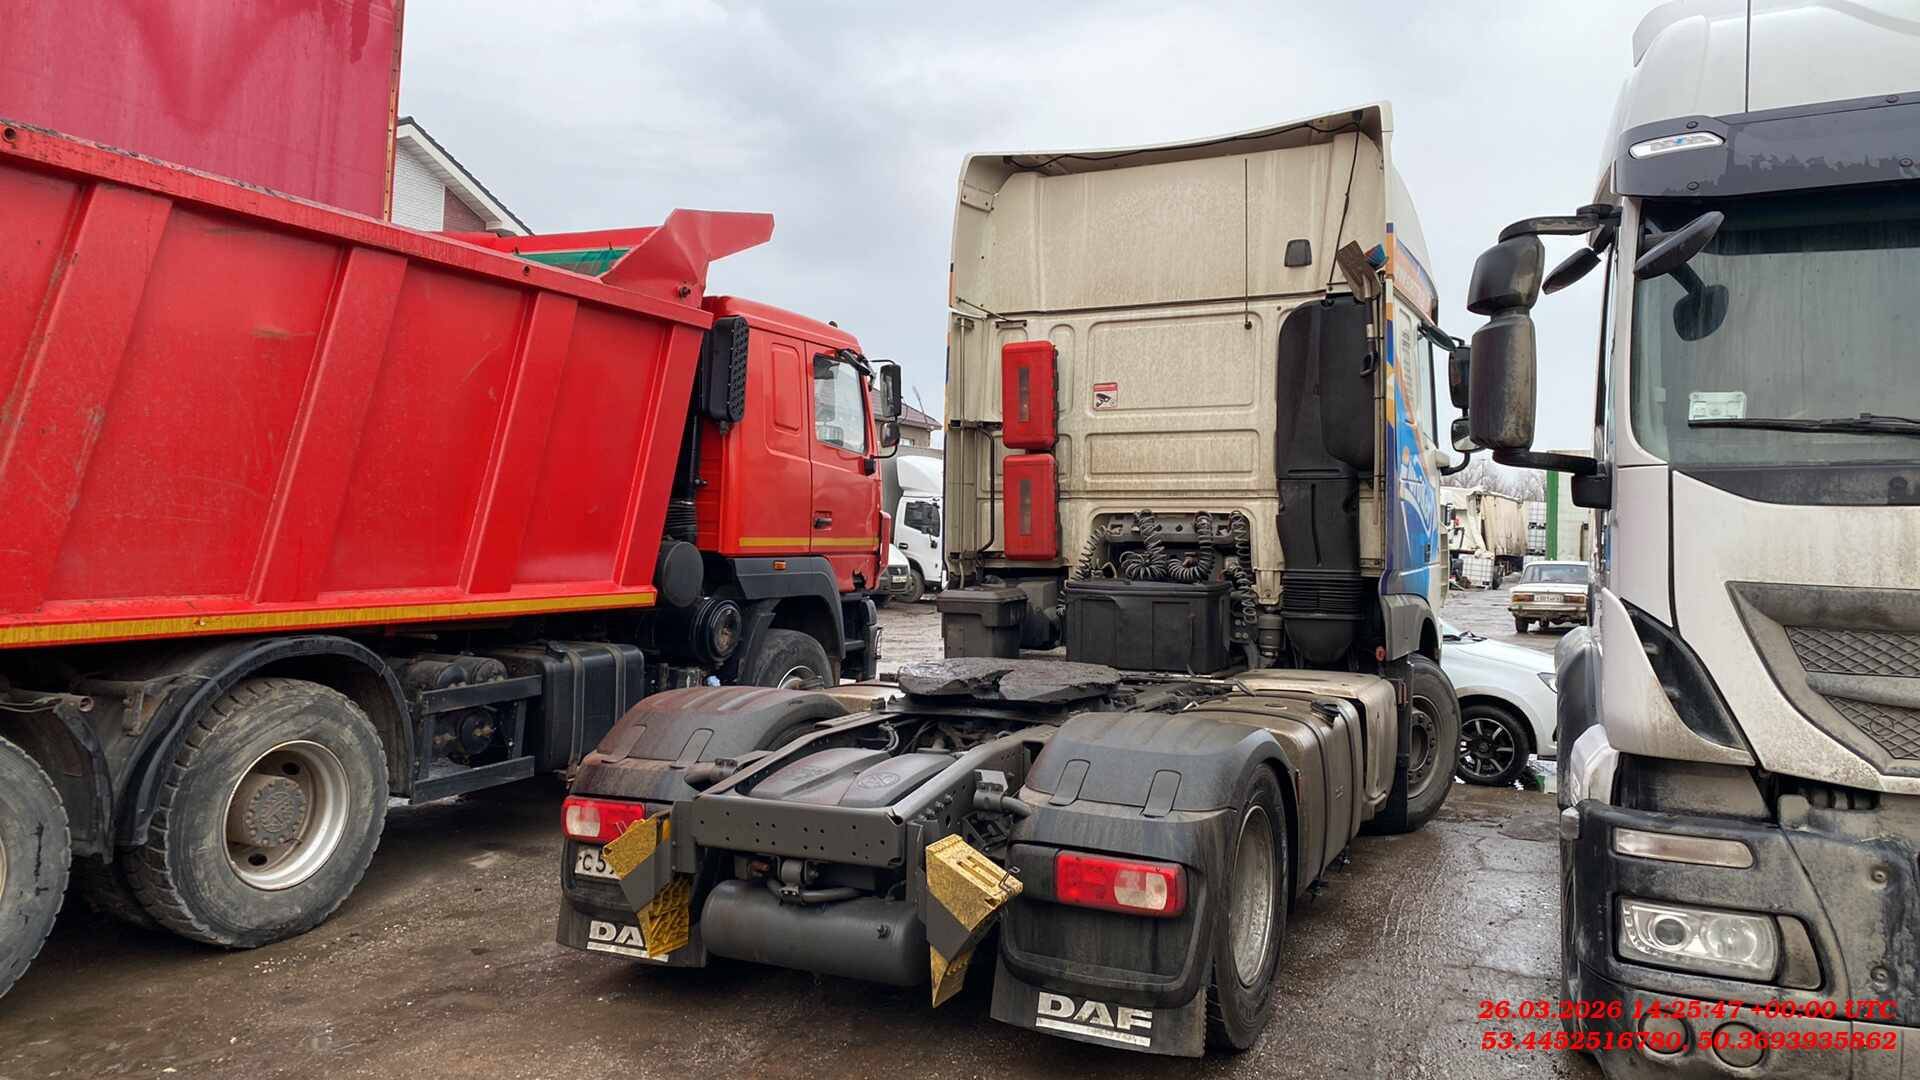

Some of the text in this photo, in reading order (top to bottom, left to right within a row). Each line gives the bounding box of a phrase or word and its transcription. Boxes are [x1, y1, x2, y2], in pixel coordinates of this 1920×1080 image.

[582, 848, 614, 875] С5
[589, 920, 645, 947] DA
[1038, 992, 1152, 1030] DAF
